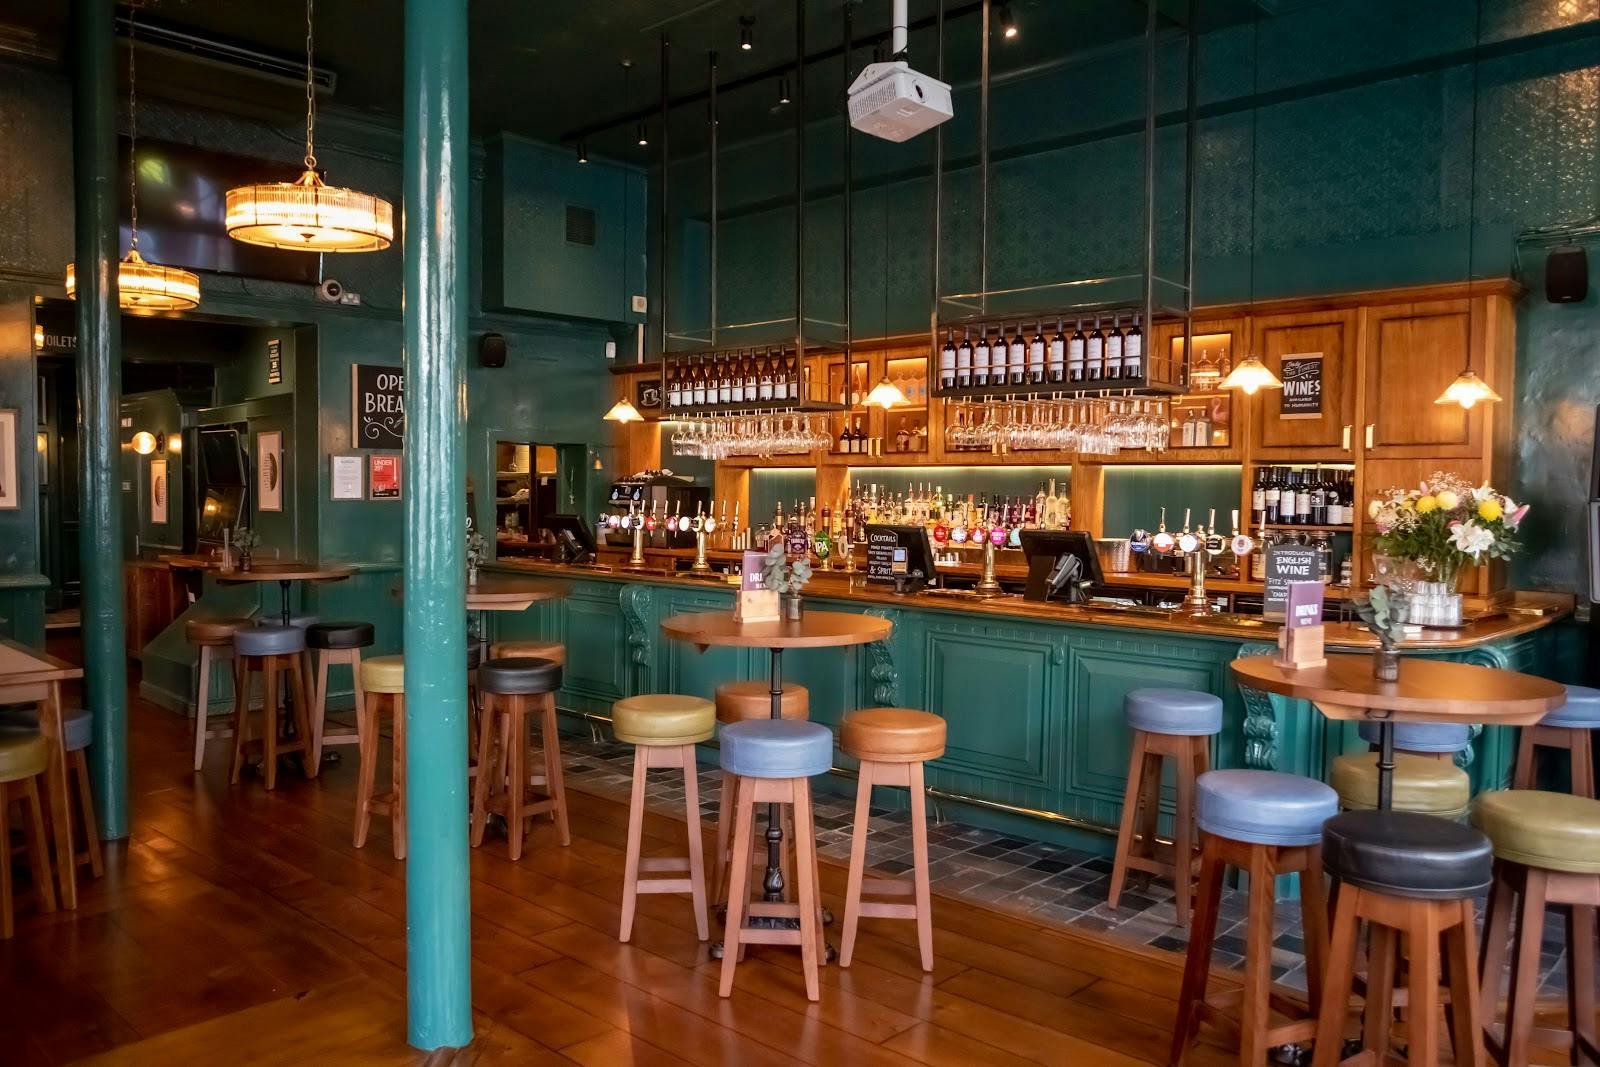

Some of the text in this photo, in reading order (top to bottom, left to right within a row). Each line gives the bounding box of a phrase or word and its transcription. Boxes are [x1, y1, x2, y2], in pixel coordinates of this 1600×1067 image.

[45, 335, 77, 348] OILETS
[815, 540, 829, 553] IPA
[1276, 556, 1312, 565] ENGLISH
[1276, 564, 1310, 576] WINE
